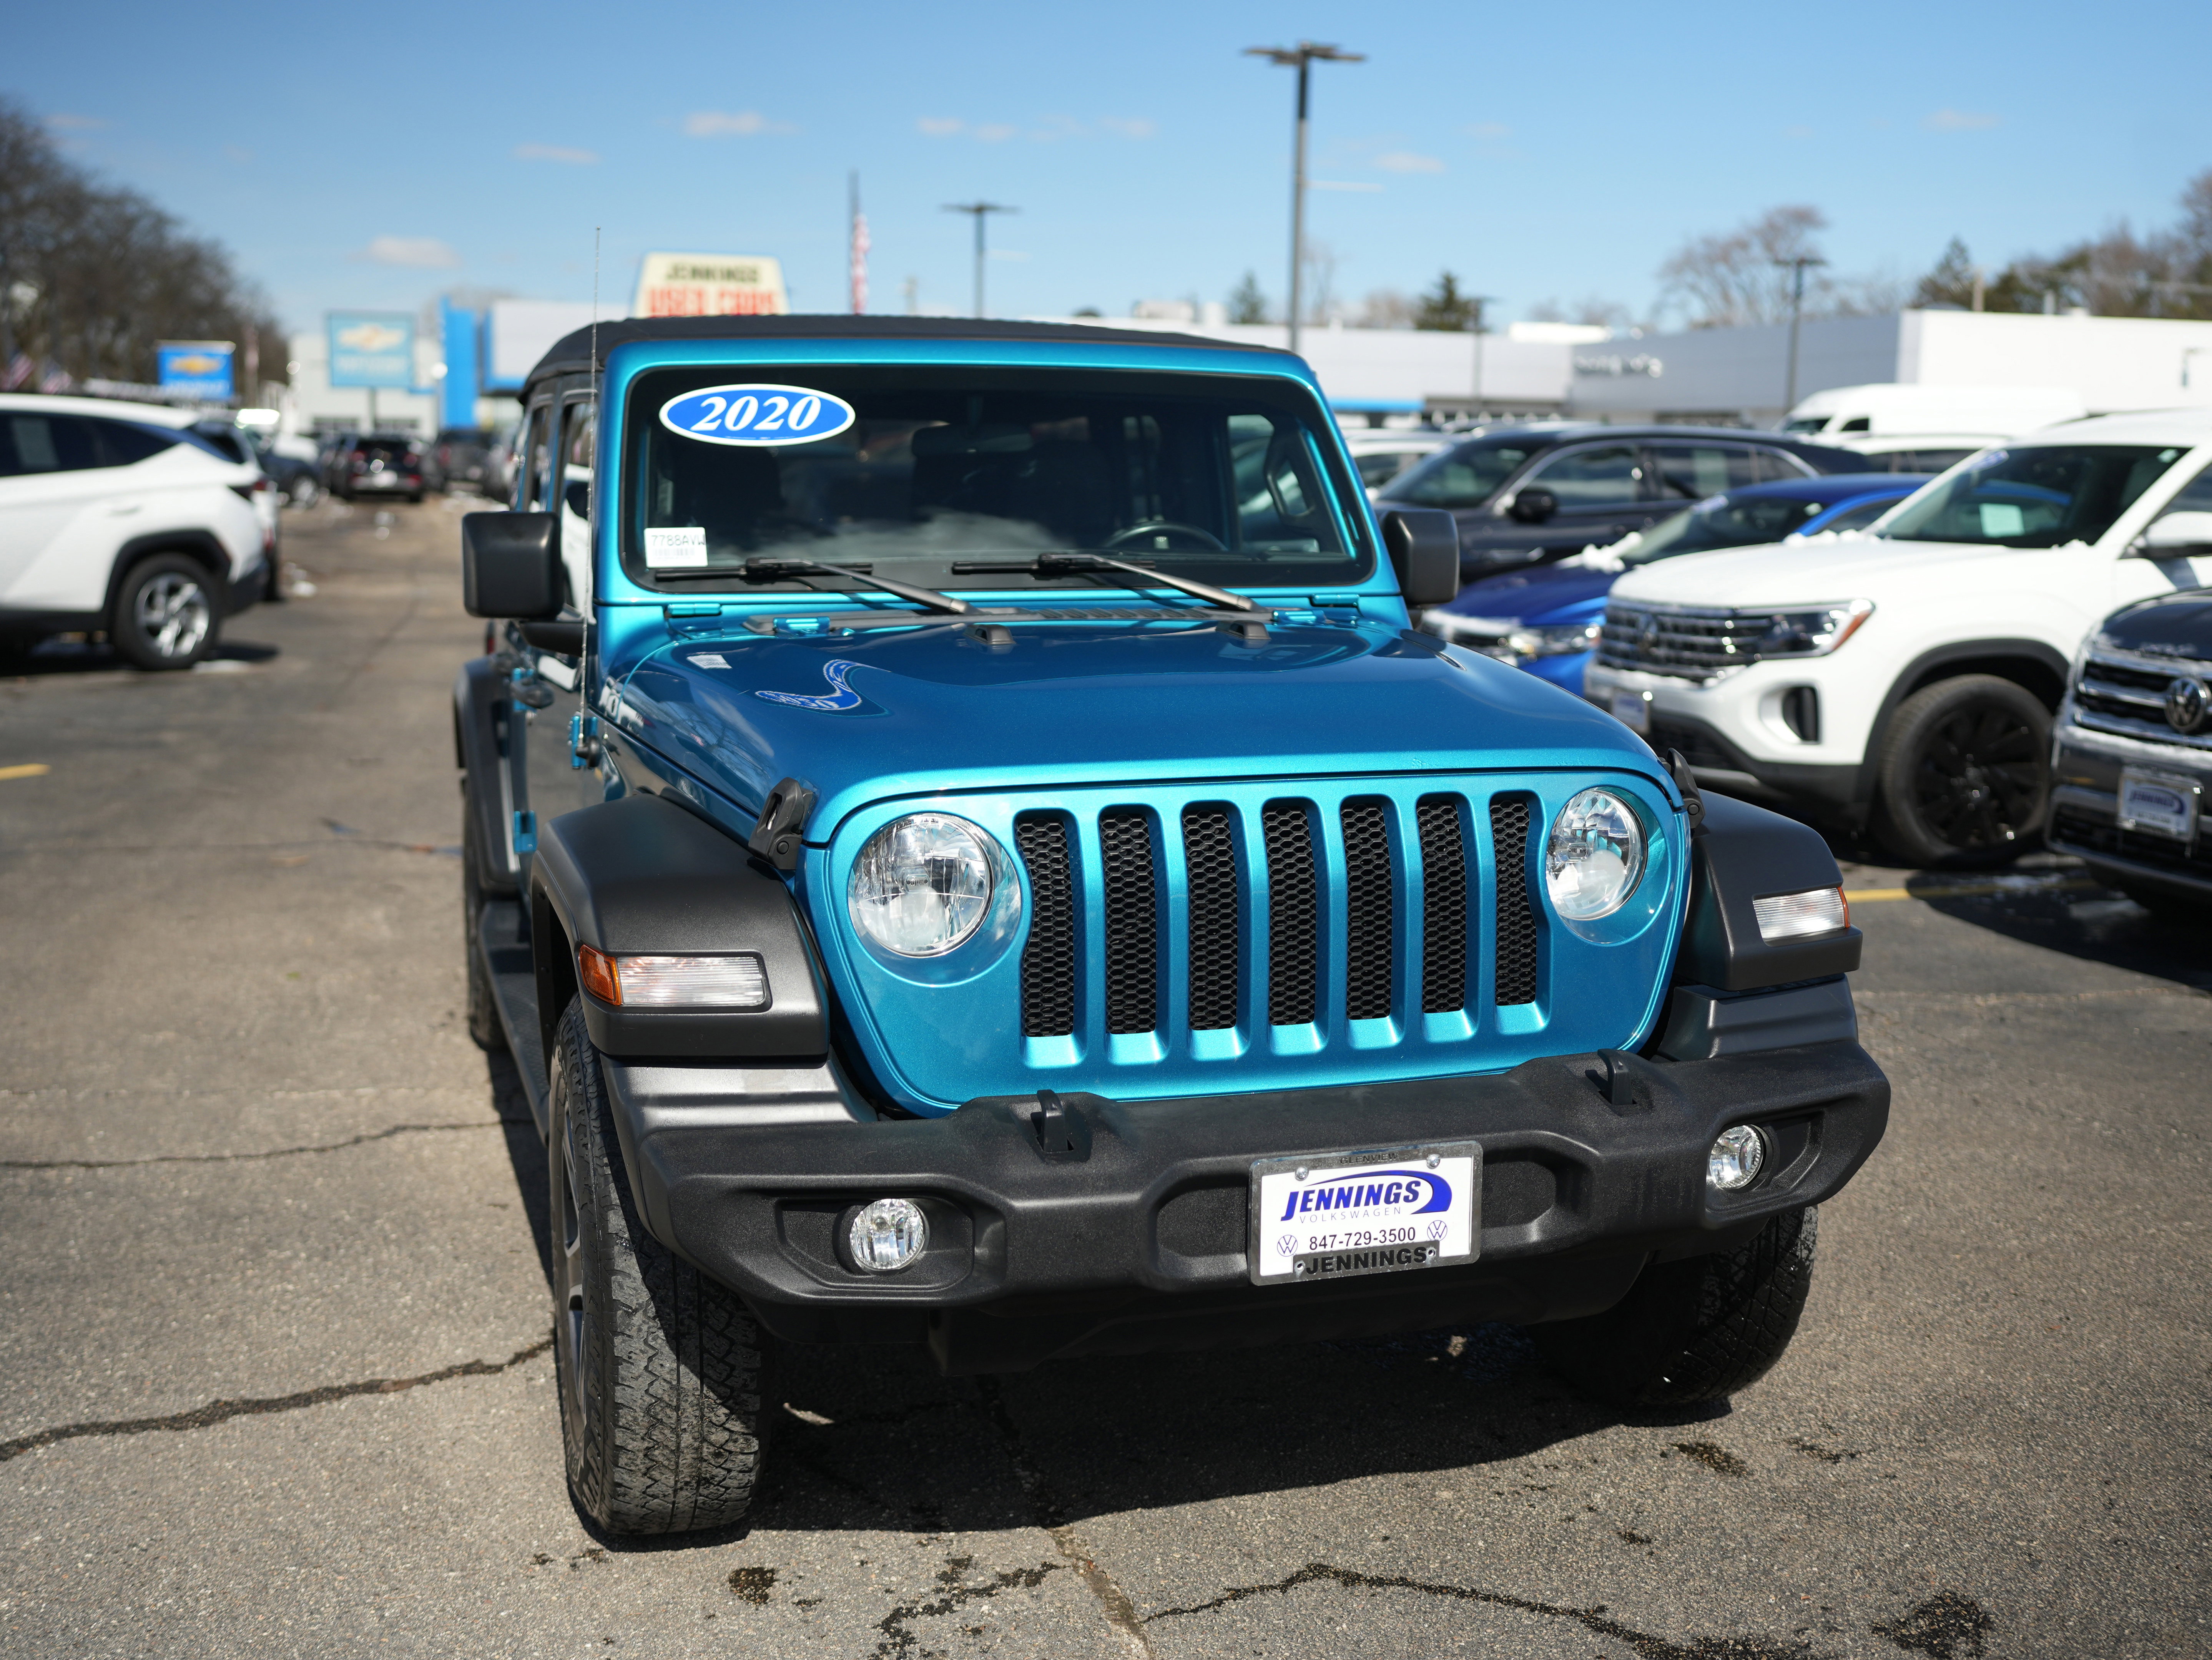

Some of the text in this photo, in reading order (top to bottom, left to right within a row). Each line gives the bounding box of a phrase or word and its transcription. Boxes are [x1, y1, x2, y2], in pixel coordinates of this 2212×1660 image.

[690, 395, 821, 431] 2020
[1340, 1152, 1398, 1164] GLENVIEW
[1280, 1180, 1421, 1222] JENNINGS
[1299, 1206, 1401, 1223] VOLKSWAGEN
[1309, 1227, 1416, 1250] 847-729-3500
[1306, 1246, 1427, 1275] JENNINGS
